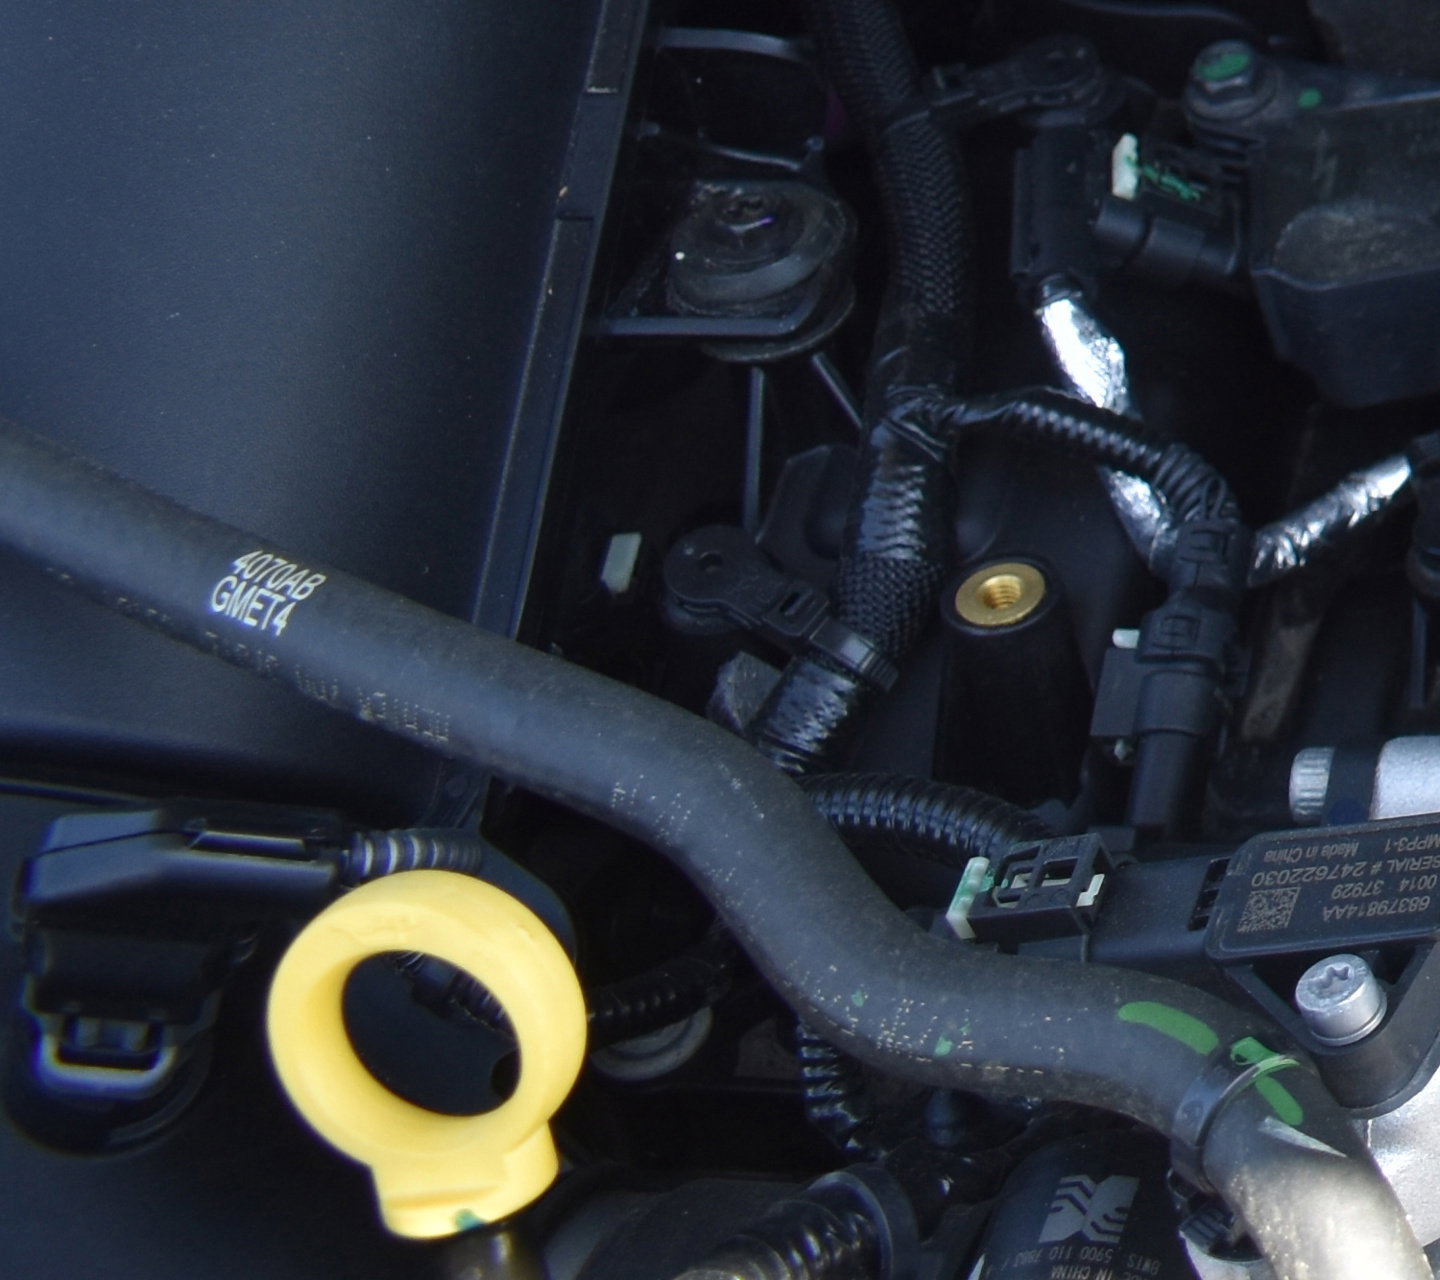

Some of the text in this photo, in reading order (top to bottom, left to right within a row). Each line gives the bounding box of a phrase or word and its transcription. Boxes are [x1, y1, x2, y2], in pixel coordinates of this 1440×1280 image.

[233, 550, 327, 601] 4070AB
[210, 575, 298, 637] GMET4
[1263, 848, 1303, 864] China
[1305, 846, 1319, 859] in
[1320, 841, 1360, 859] Made
[1250, 860, 1368, 888] 247622030
[1369, 861, 1383, 877] #
[1330, 873, 1439, 900] 0014 37929
[1322, 894, 1431, 922] 68379814AA
